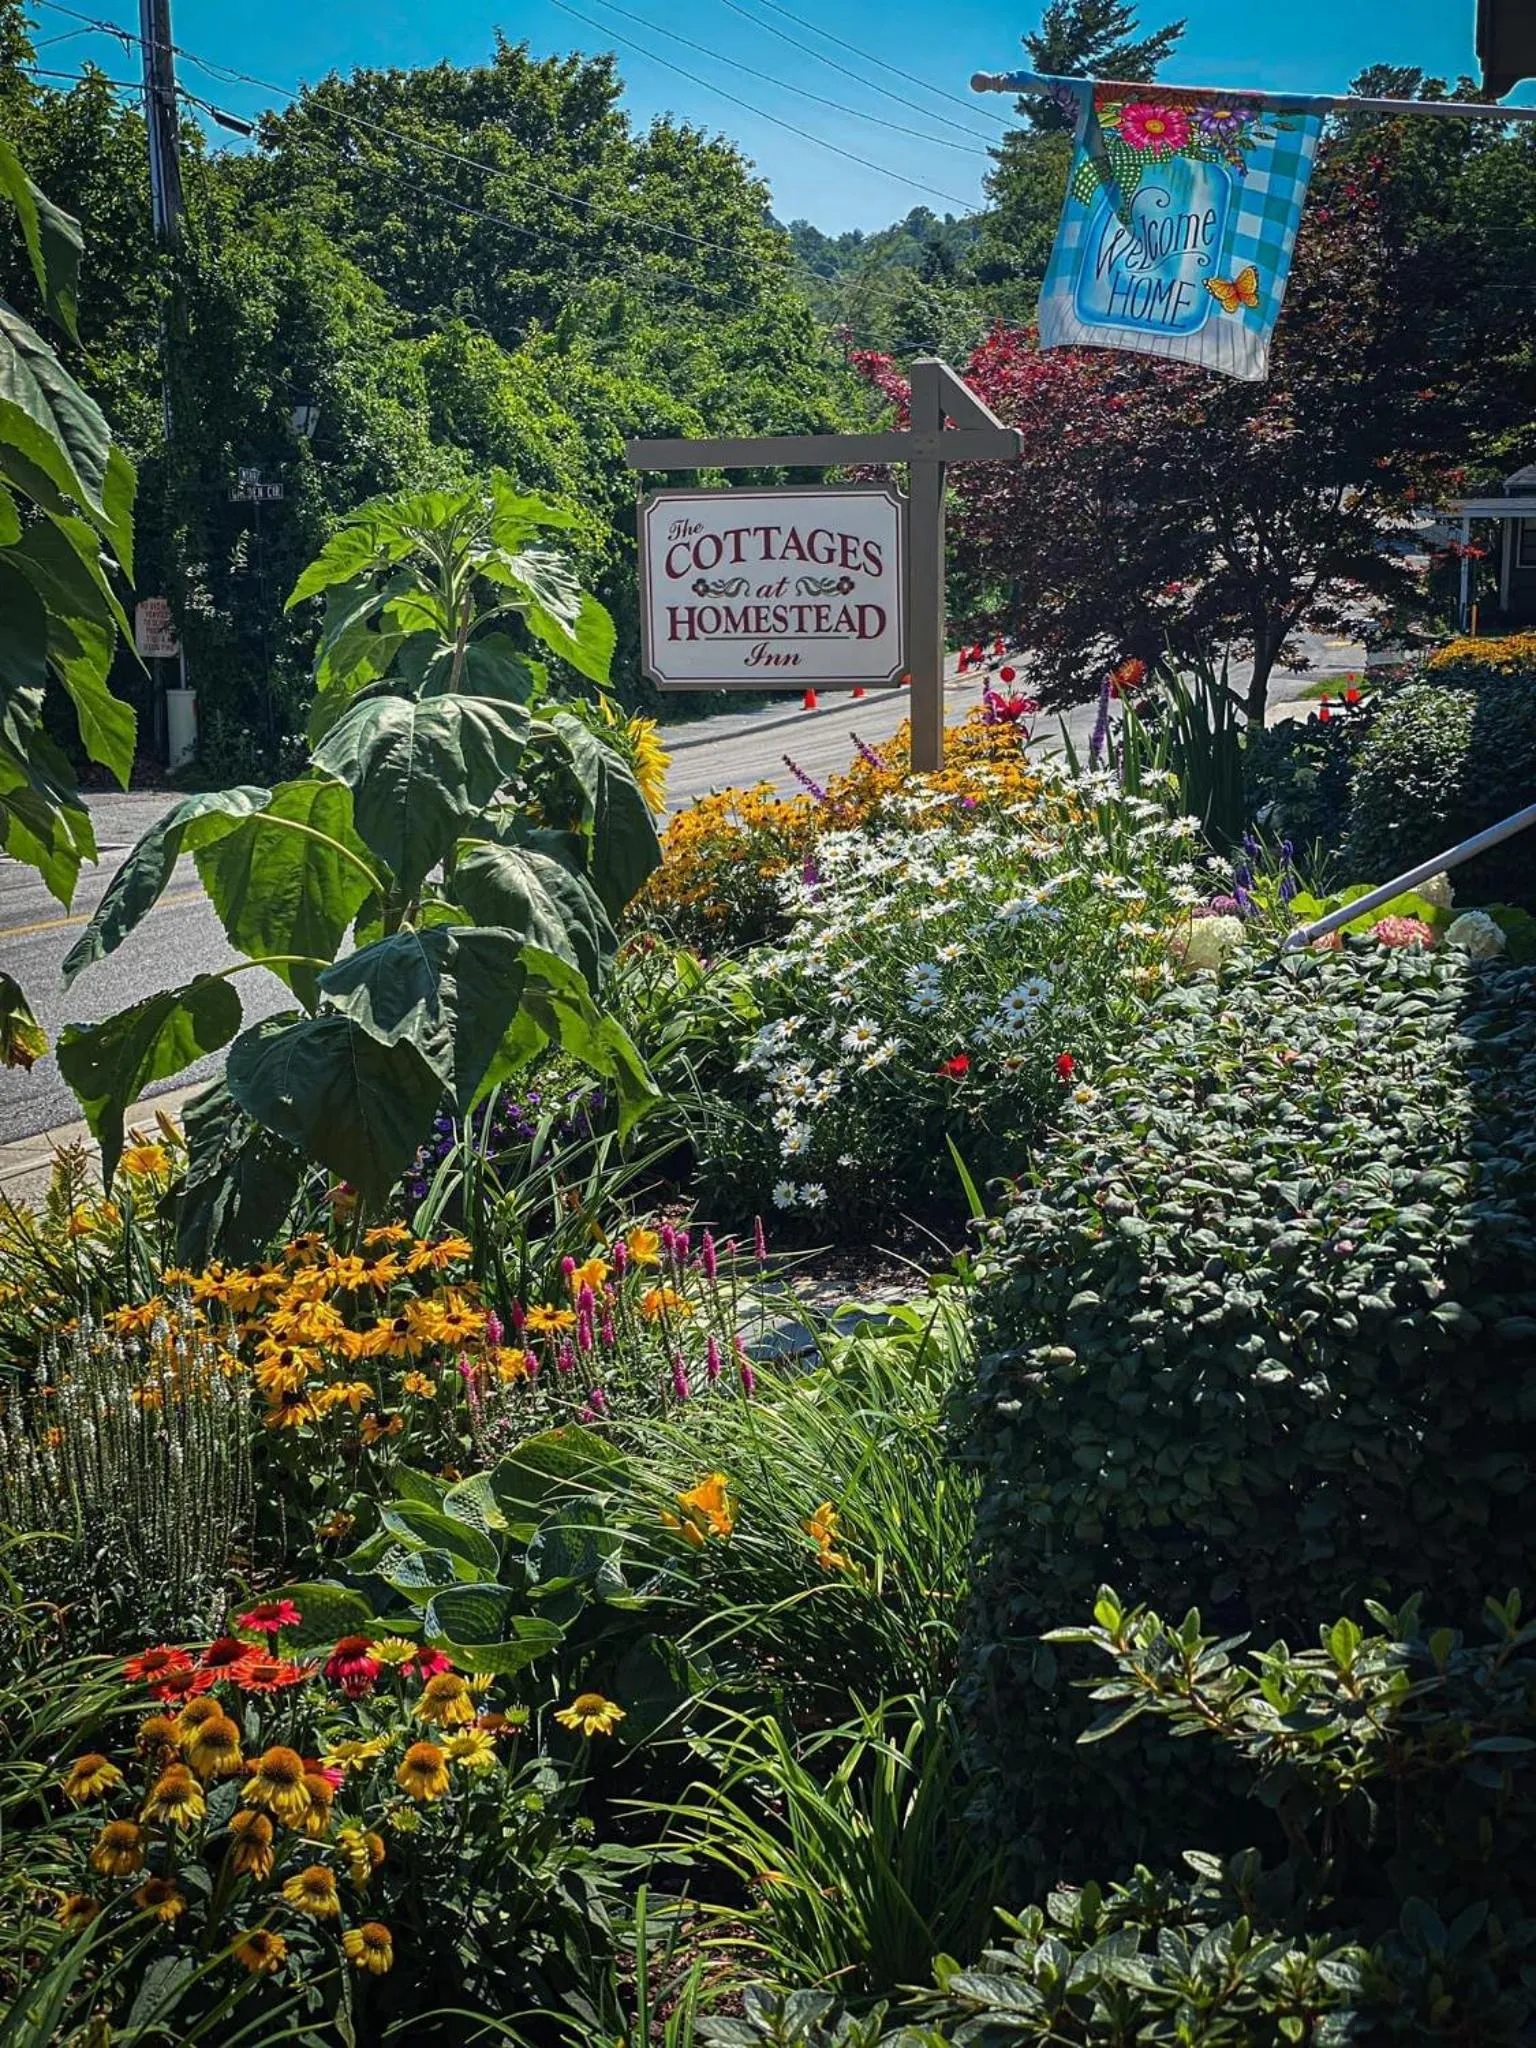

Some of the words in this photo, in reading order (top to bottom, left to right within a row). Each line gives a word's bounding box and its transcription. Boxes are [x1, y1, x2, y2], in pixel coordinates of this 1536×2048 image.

[1096, 186, 1217, 281] Welcome
[1106, 275, 1197, 329] HOME
[667, 518, 704, 541] The
[665, 526, 883, 579] COTTAGES
[756, 576, 790, 598] at
[665, 604, 887, 641] HOMESTEAD
[744, 642, 802, 667] Inn
